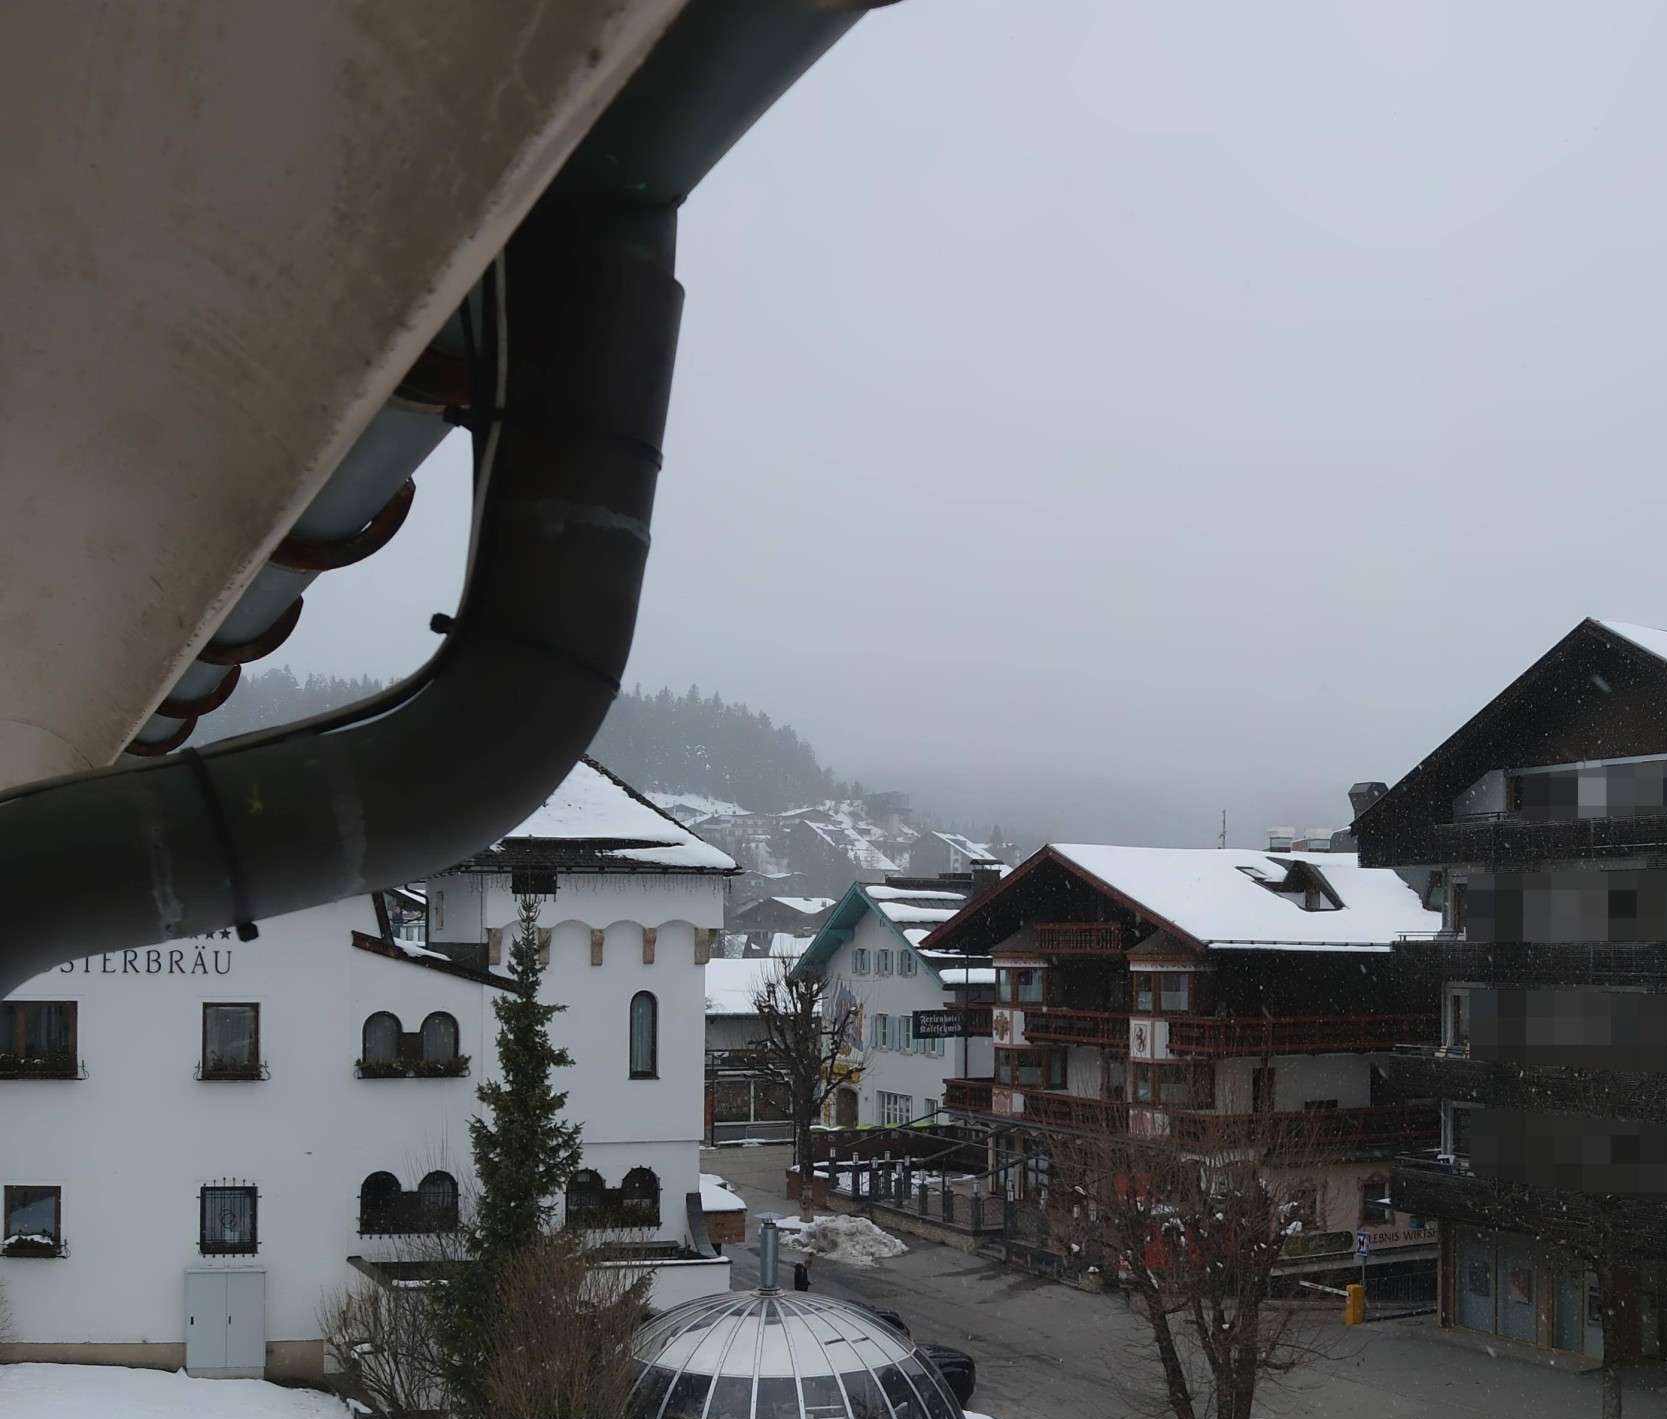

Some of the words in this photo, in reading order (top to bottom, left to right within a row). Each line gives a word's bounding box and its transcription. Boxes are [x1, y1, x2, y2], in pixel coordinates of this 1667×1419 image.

[60, 945, 232, 974] STERBRÄU
[1368, 1233, 1400, 1244] LEBNIS
[1403, 1229, 1438, 1241] WIRTSH
